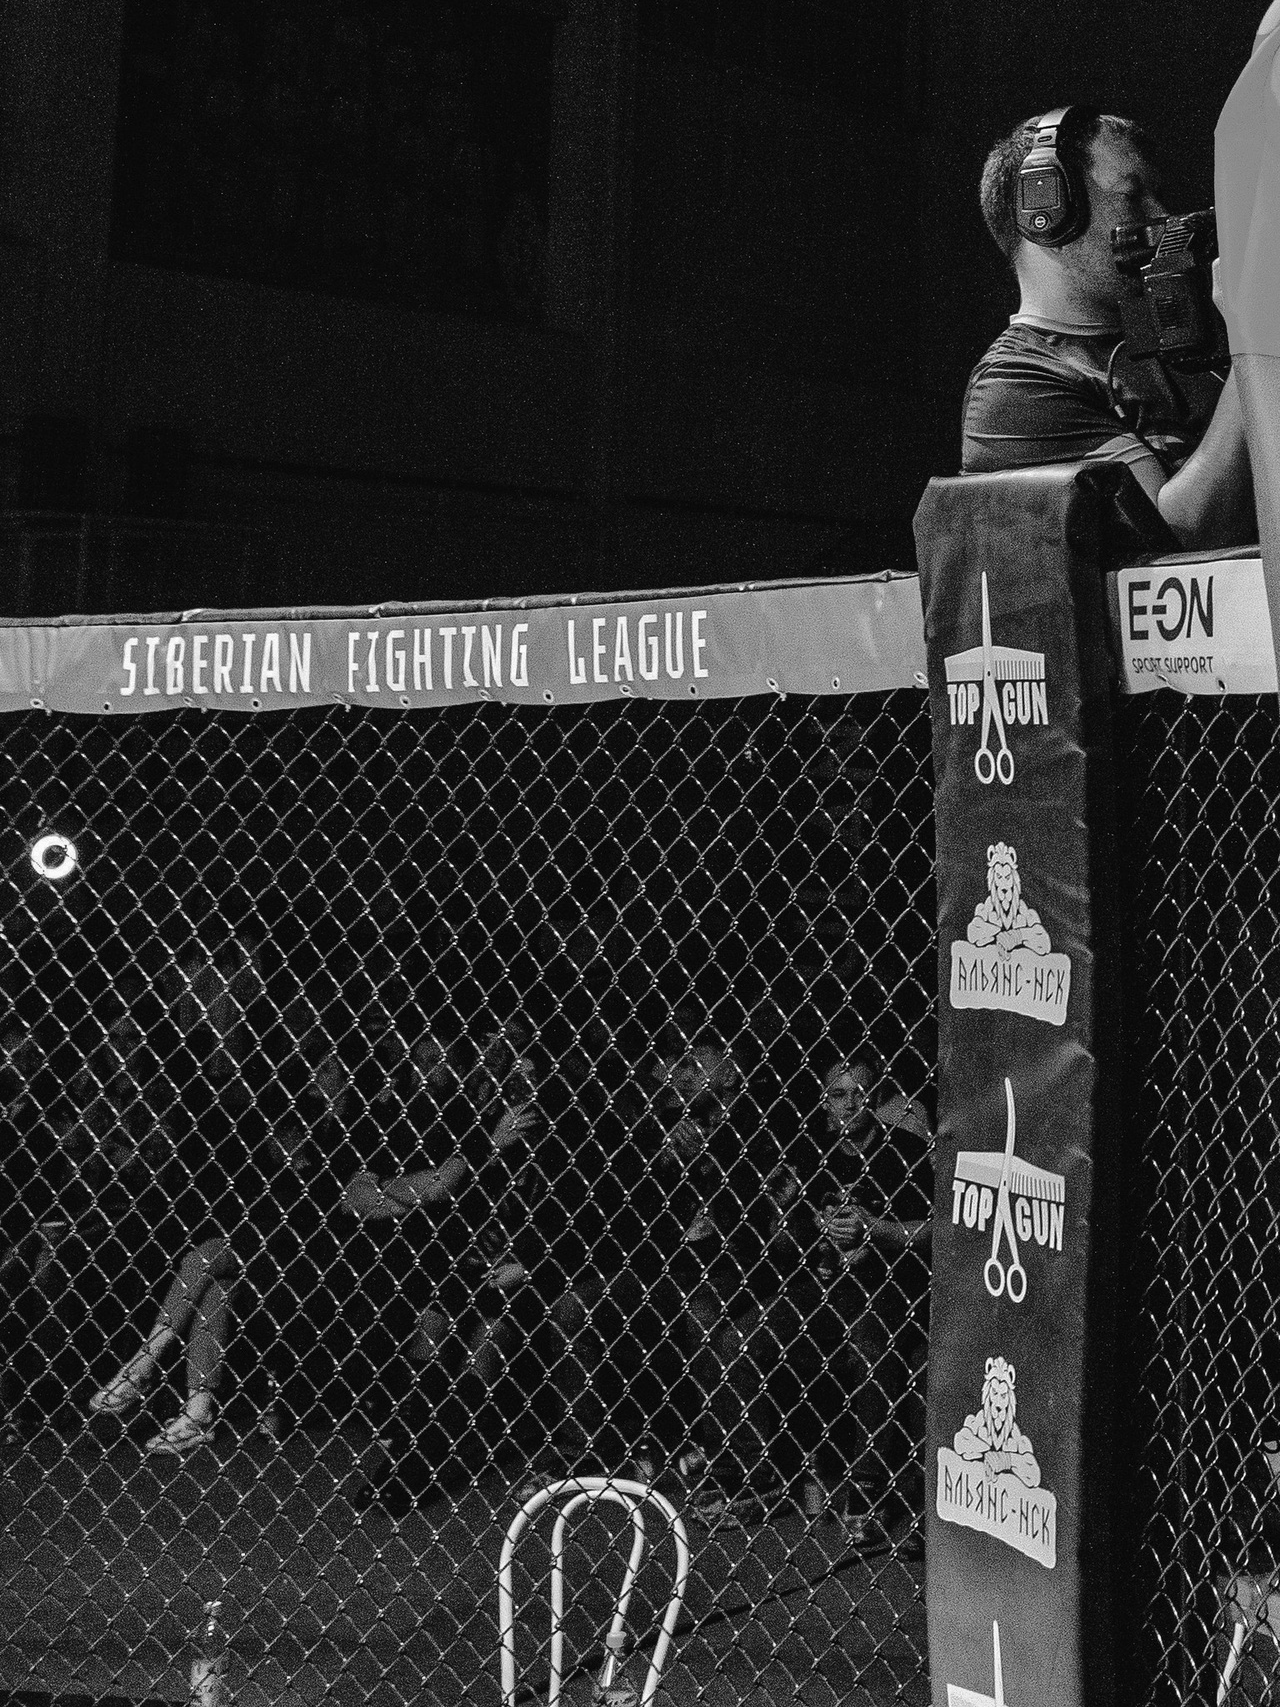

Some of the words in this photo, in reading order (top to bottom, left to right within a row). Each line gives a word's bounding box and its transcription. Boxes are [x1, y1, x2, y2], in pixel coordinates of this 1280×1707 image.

[120, 632, 311, 696] SIBERIAN
[348, 623, 529, 693] FIGHTING
[568, 610, 709, 684] LEAGUE
[1164, 656, 1213, 673] SUPPORT
[947, 683, 980, 725] TOP
[1002, 681, 1049, 725] GUN
[958, 956, 1065, 1005] АЛЬЯНС-НСК
[952, 1179, 994, 1232] TOP
[1015, 1197, 1065, 1252] GUN
[945, 1465, 1050, 1546] АЛЬЯНС-НСК
